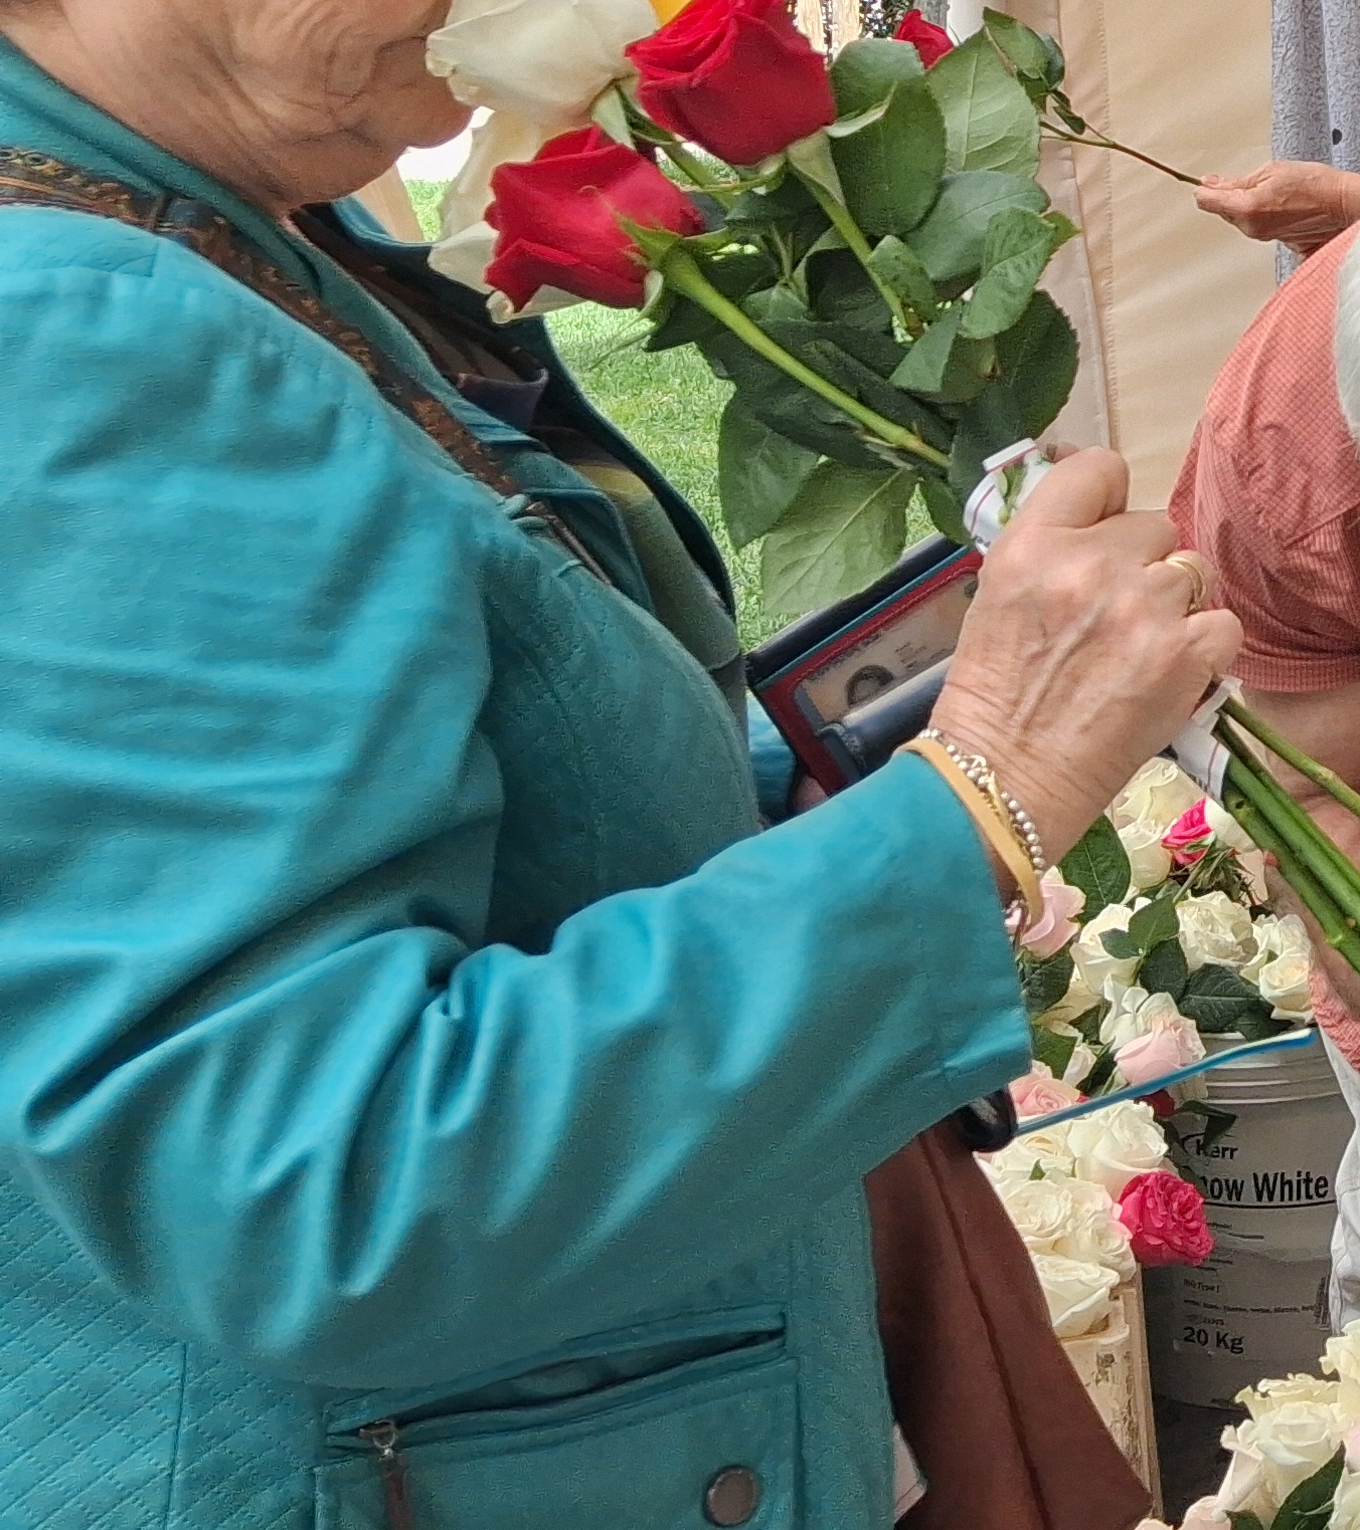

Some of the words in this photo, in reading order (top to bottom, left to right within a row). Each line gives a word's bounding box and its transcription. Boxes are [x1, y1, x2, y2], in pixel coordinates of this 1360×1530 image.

[1252, 1170, 1329, 1203] White
[1183, 1326, 1208, 1346] 20
[1216, 1330, 1245, 1354] Kg
